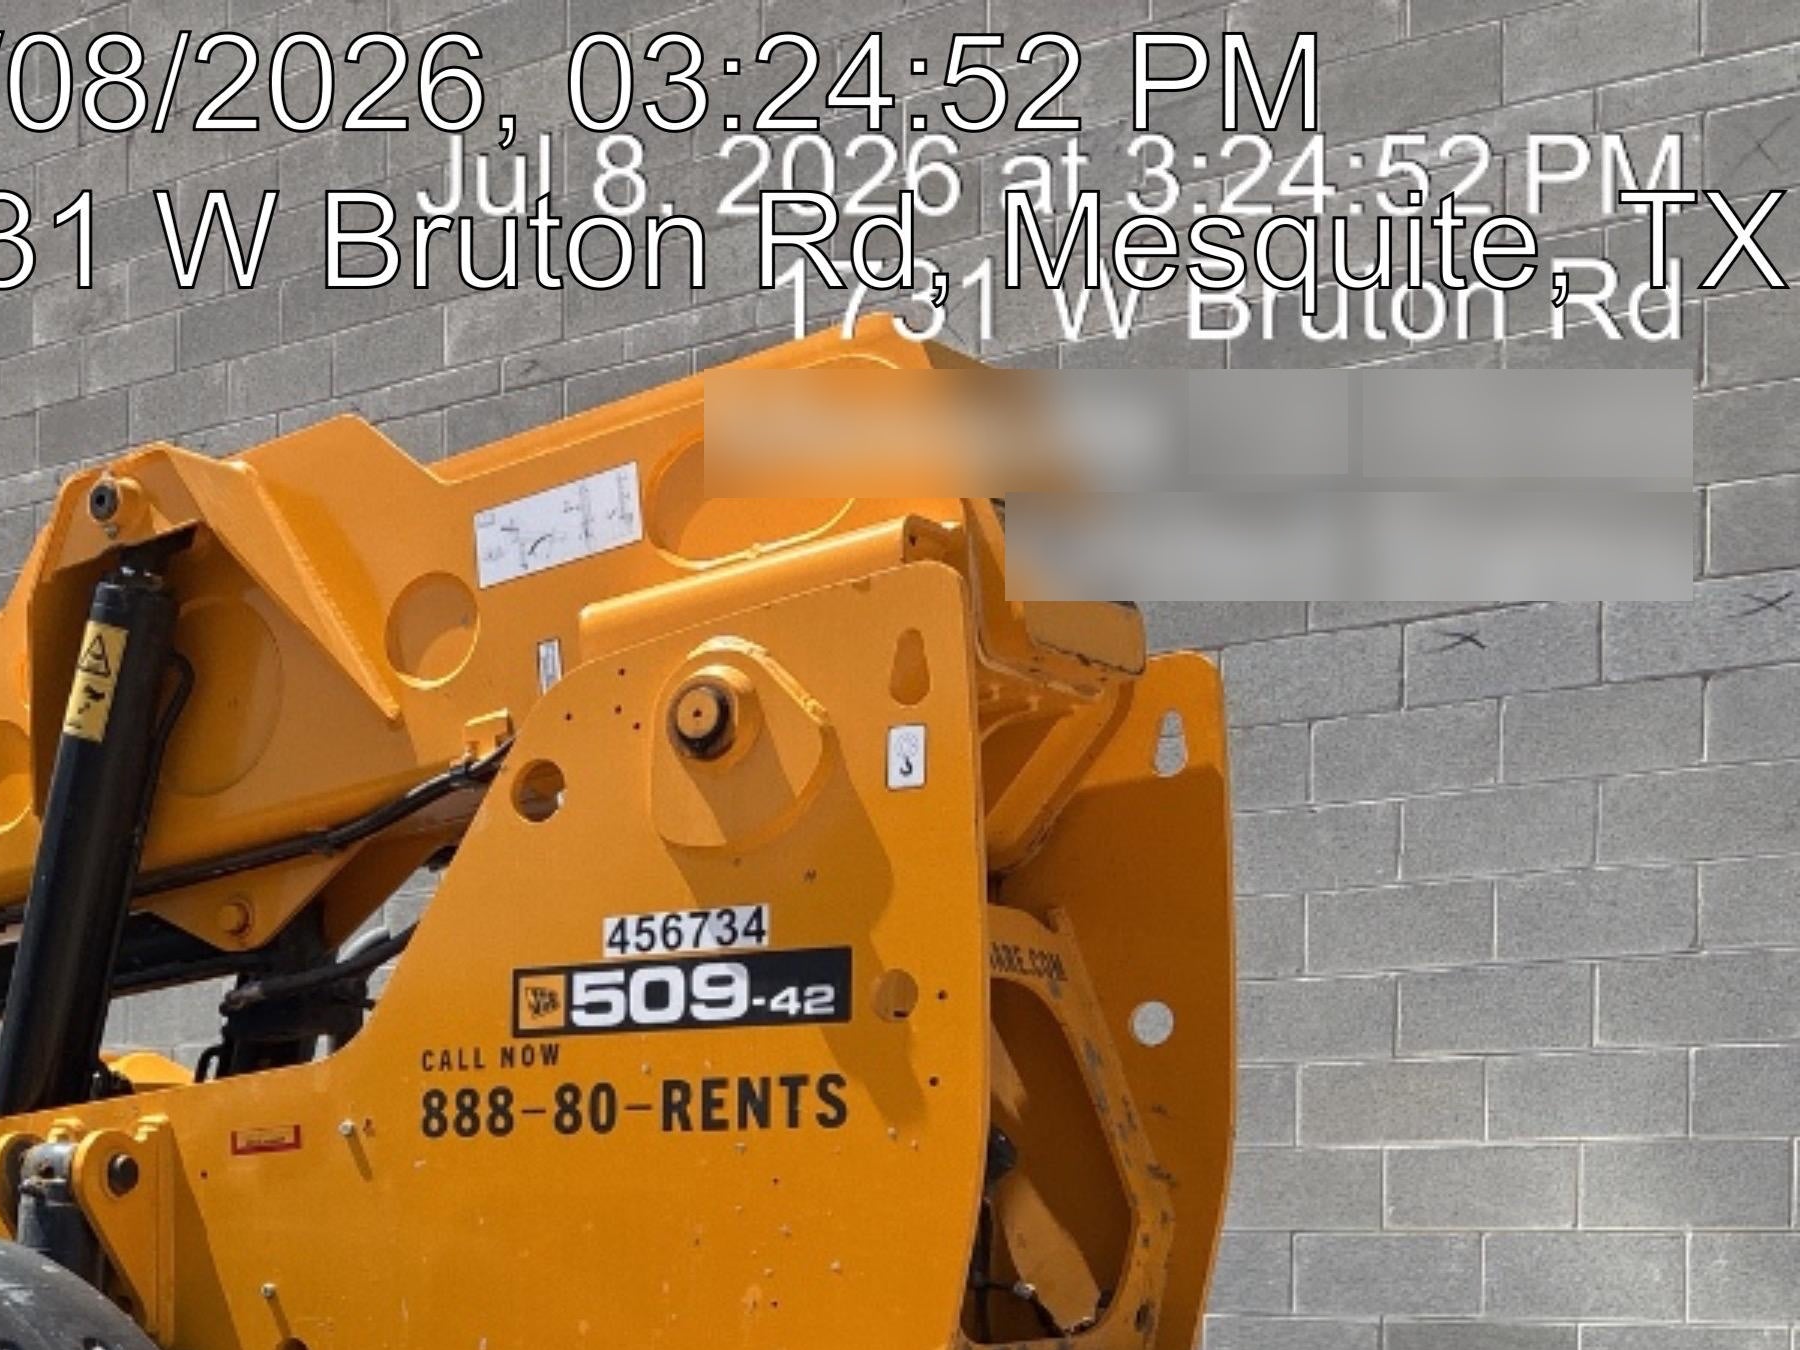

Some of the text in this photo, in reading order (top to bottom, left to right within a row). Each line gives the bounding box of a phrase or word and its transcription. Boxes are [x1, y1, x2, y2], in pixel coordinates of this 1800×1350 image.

[606, 905, 767, 955] 456734
[571, 962, 836, 1028] 509-42
[421, 1043, 561, 1073] CALL NOW
[421, 1073, 848, 1139] 888-80-RENTS
